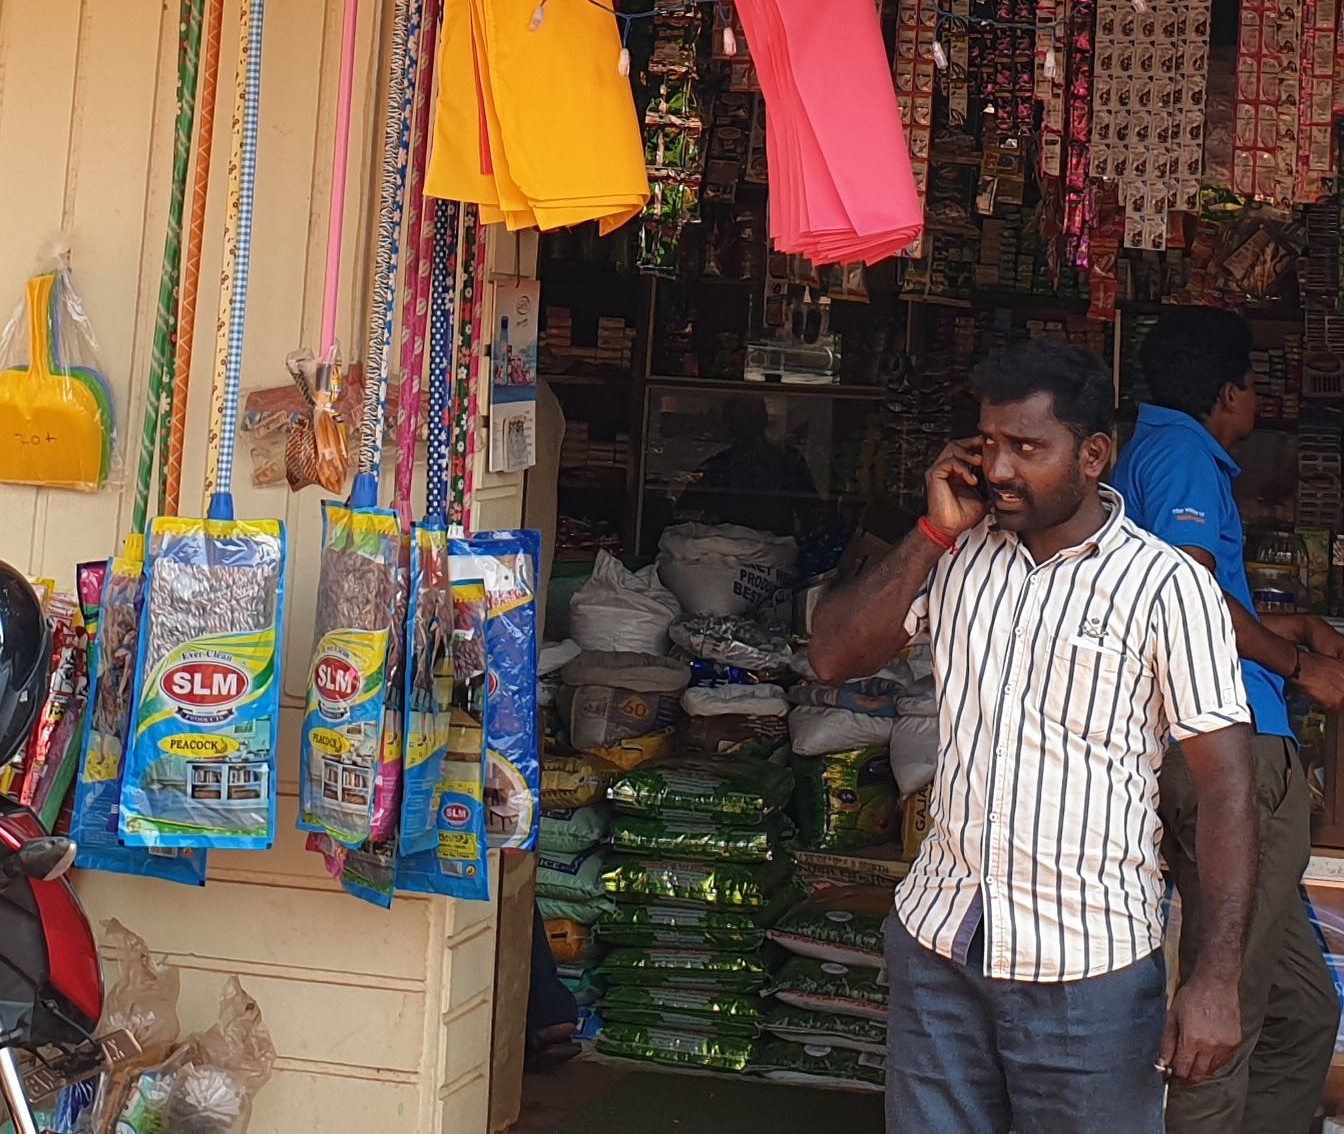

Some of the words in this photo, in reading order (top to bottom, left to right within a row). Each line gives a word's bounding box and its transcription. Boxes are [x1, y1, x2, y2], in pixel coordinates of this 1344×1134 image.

[171, 671, 238, 696] SLM
[317, 664, 353, 694] SLM
[170, 739, 219, 751] PEACOCK
